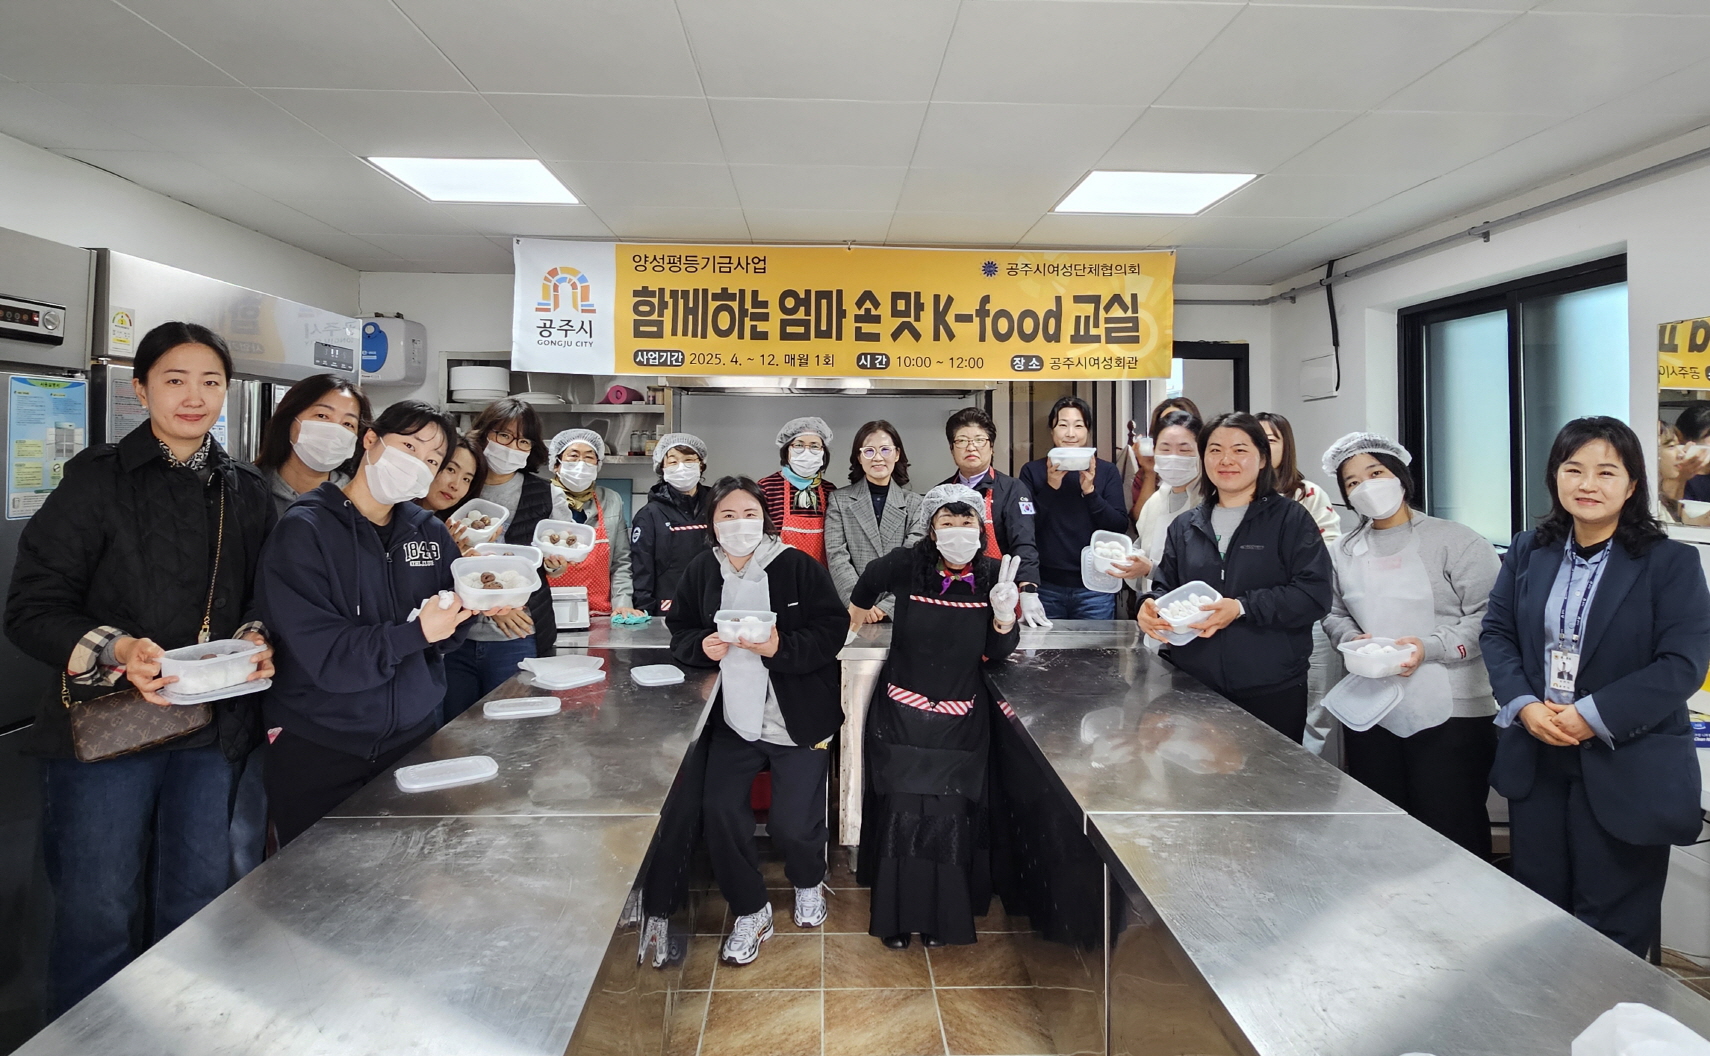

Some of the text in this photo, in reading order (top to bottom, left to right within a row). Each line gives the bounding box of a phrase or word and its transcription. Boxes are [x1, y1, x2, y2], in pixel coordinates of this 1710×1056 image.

[632, 253, 767, 274] 양성평등기금사업
[1005, 262, 1141, 277] 공주시여성단체협의회
[632, 286, 770, 341] 함께하는
[778, 288, 847, 342] 엄마
[932, 294, 1063, 343] K-food
[1070, 293, 1141, 344] 교실
[536, 318, 594, 339] 공주시
[536, 339, 594, 348] GONGJU CITY
[635, 351, 683, 367] 사업기간
[689, 352, 726, 367] 2025.
[729, 353, 743, 367] 4.
[760, 353, 779, 367] 12.
[784, 353, 809, 368] 매월
[814, 353, 835, 368] 1회
[896, 356, 931, 368] 10:00
[948, 356, 984, 369] 12:00
[1048, 356, 1139, 370] 공주시여성회관
